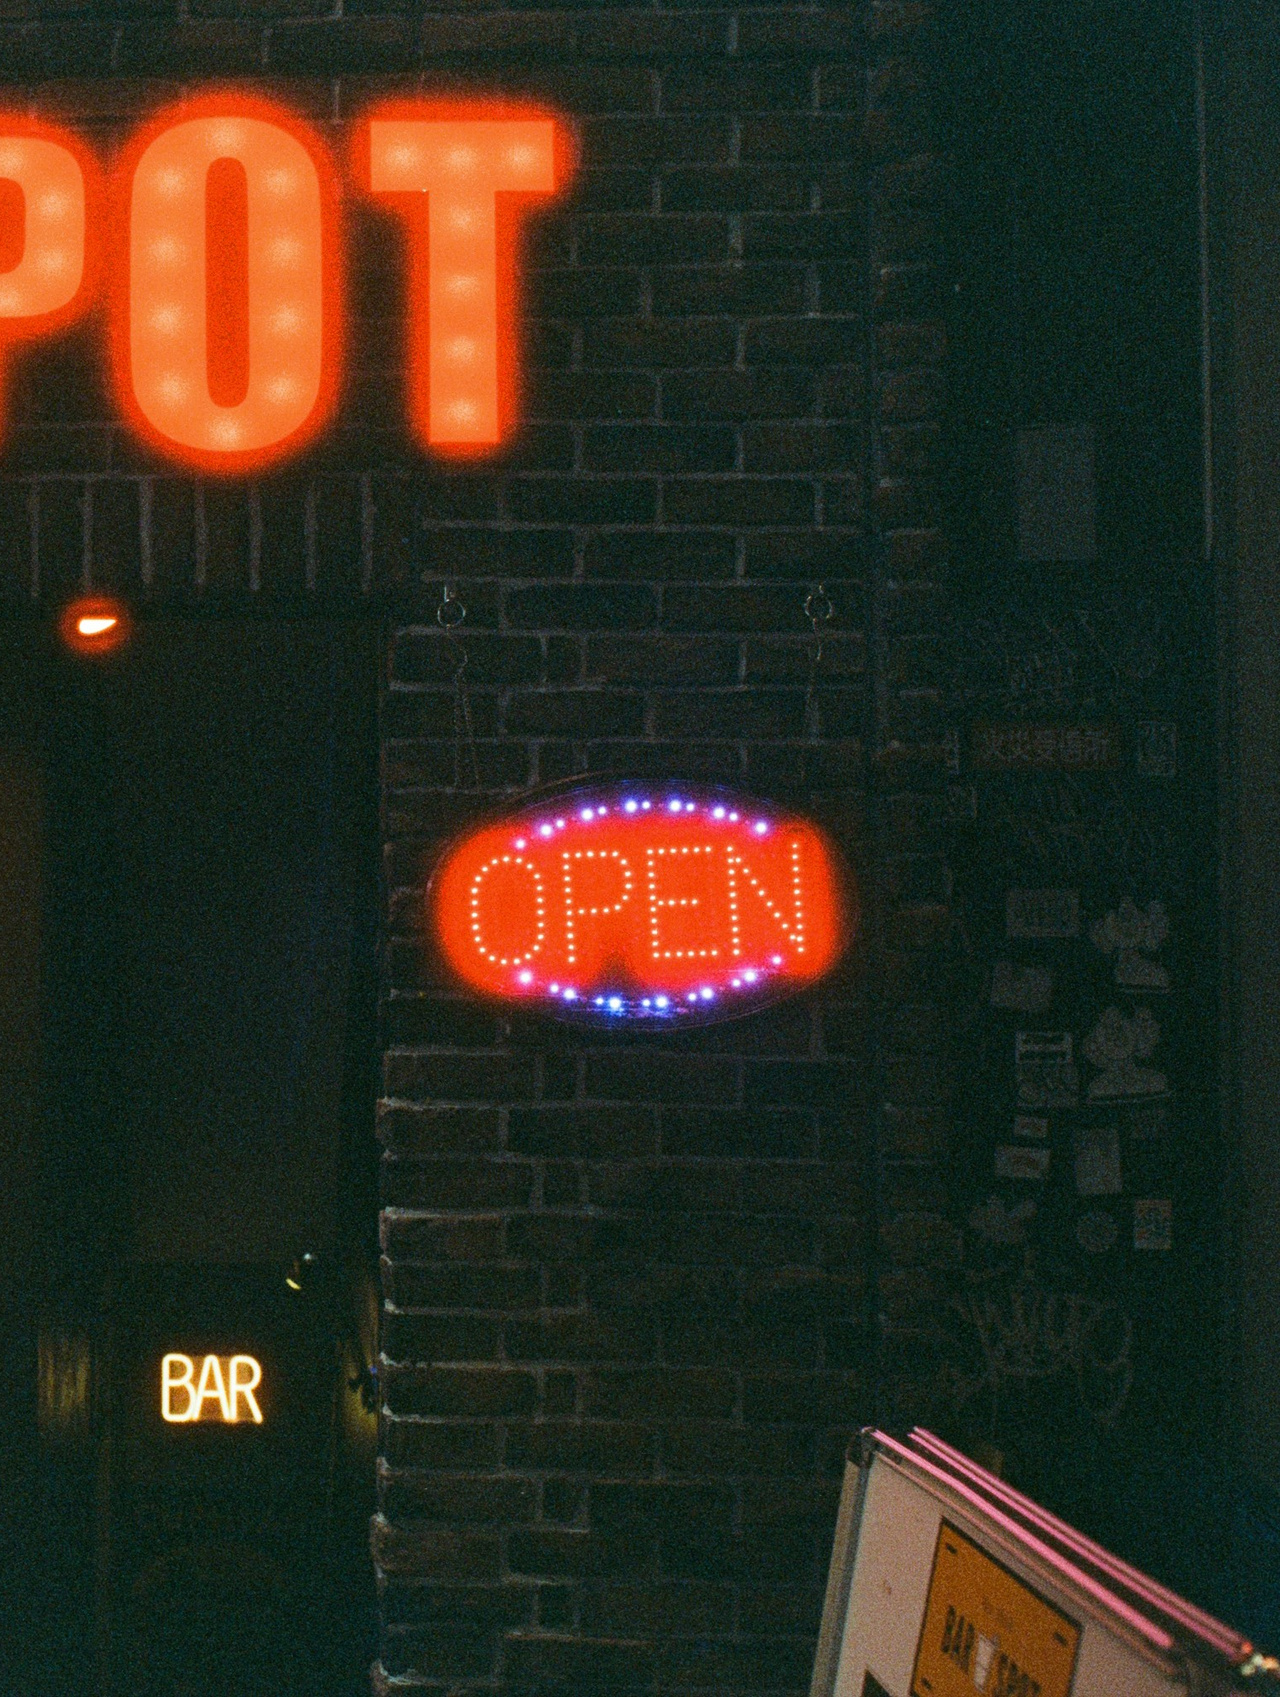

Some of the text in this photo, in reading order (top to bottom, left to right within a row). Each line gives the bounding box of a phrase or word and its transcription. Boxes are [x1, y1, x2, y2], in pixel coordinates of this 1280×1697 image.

[468, 840, 809, 968] OPEN
[160, 1353, 263, 1423] BAR
[941, 1605, 975, 1674] BAR
